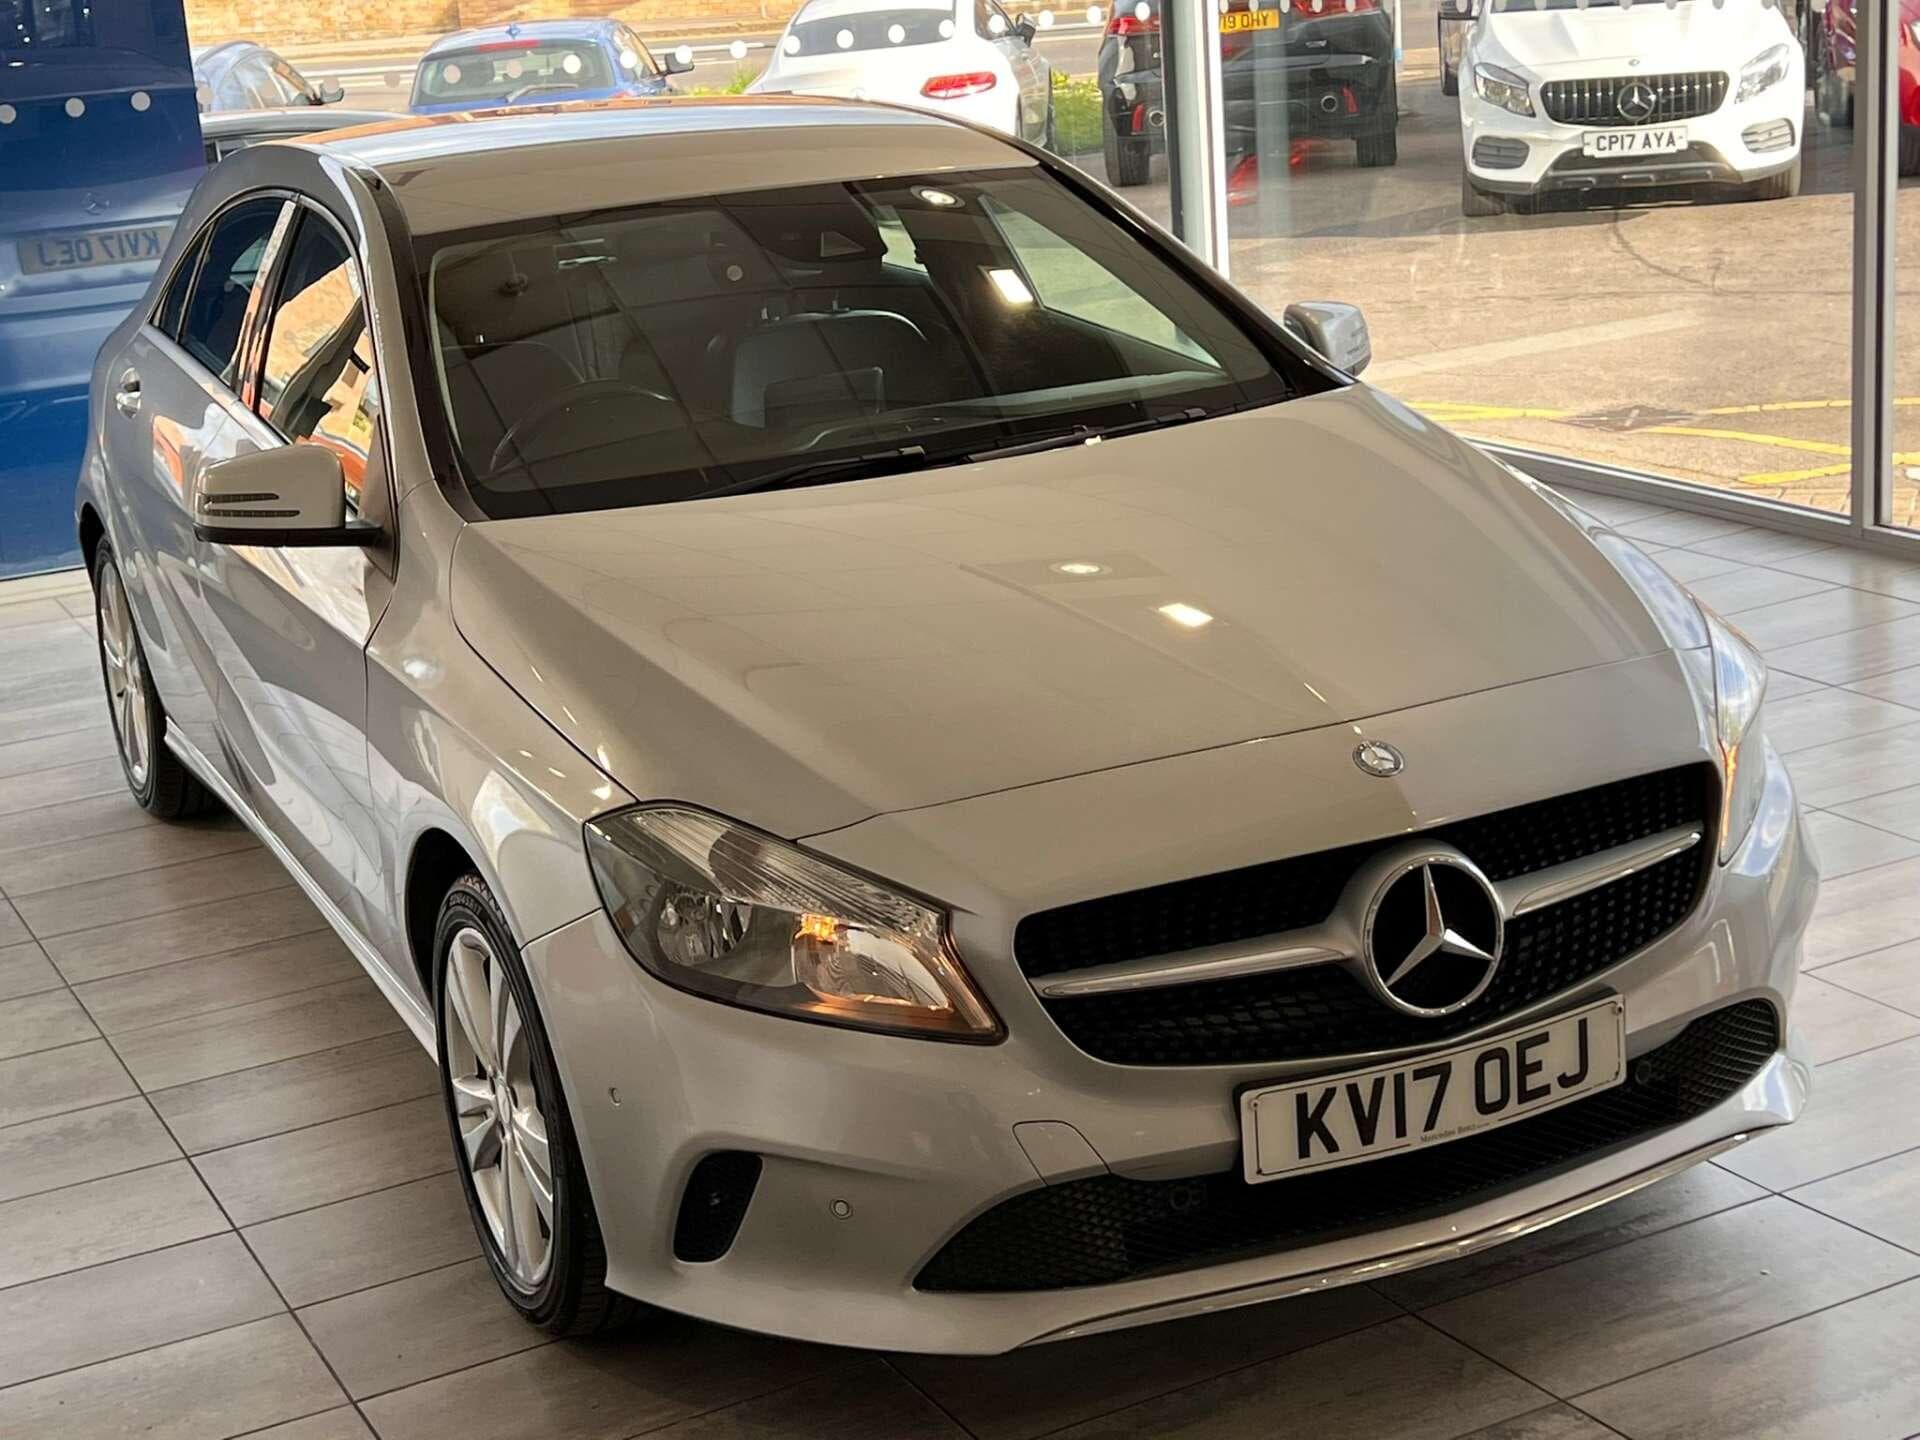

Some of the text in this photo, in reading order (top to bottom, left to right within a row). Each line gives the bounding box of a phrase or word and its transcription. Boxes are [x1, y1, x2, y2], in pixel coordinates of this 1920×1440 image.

[1240, 13, 1269, 28] OHY
[1595, 130, 1676, 152] CP17 AYA
[1295, 1017, 1589, 1160] KV17 OEJ
